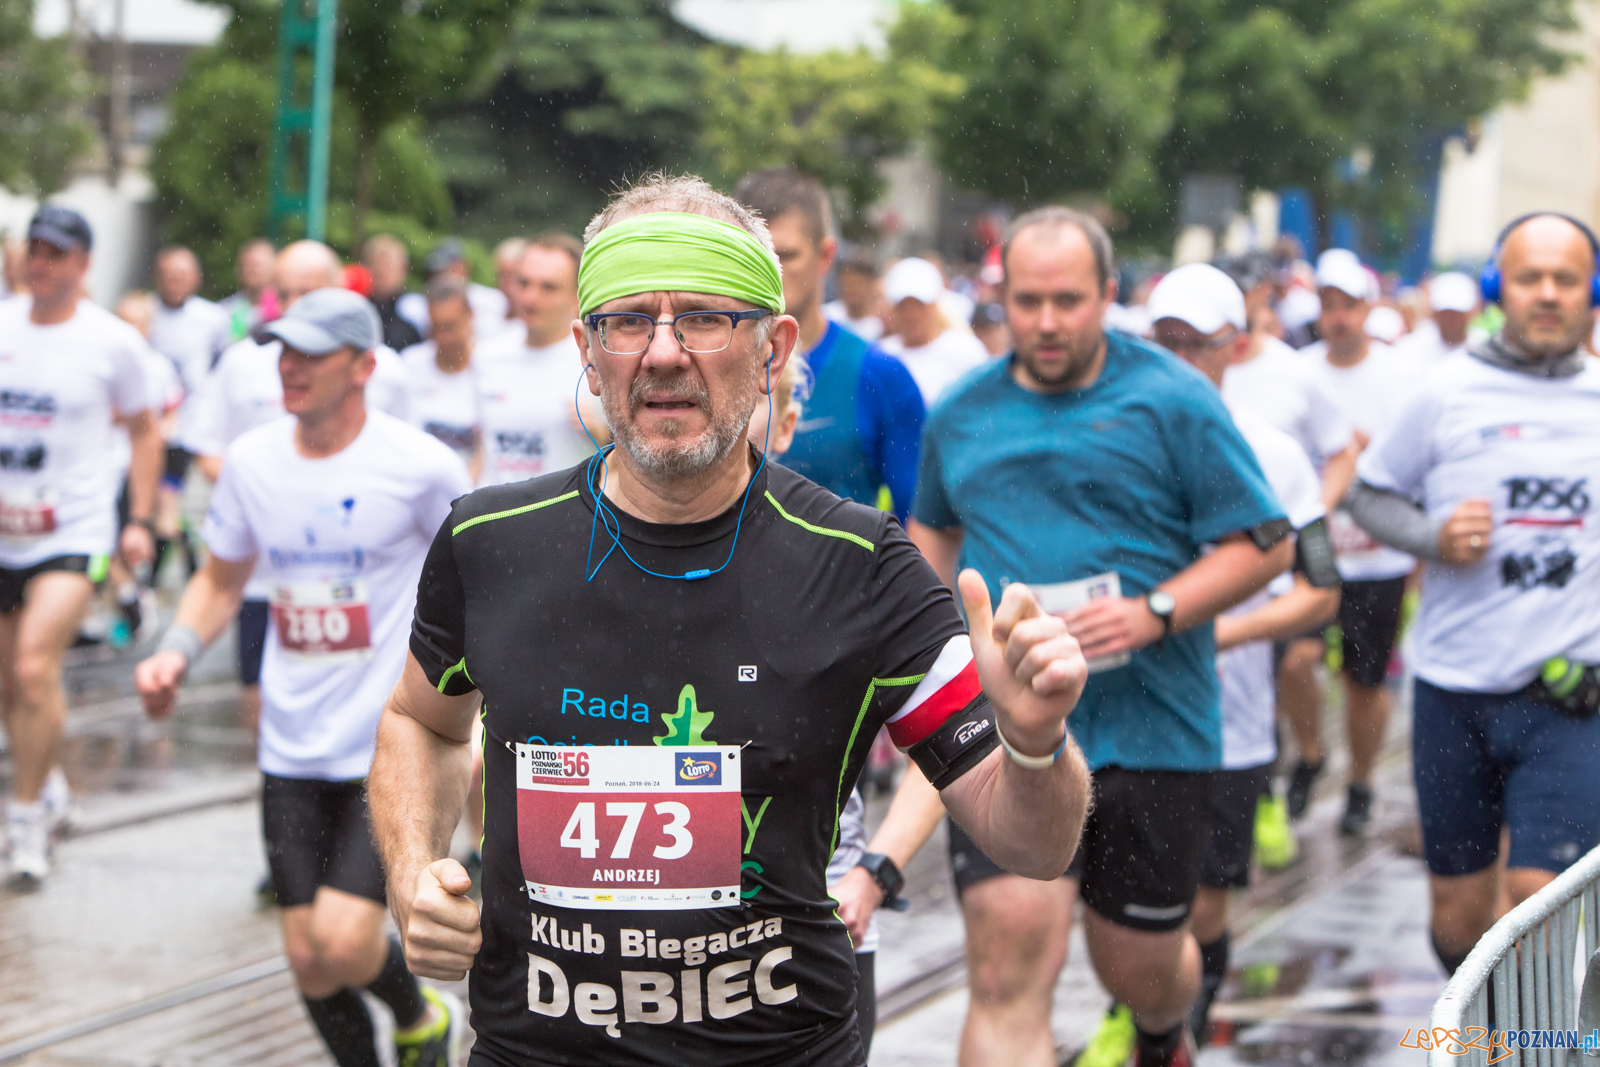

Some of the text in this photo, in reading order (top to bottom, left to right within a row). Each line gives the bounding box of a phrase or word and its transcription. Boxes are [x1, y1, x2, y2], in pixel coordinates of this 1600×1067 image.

[1502, 476, 1590, 514] 1956
[560, 688, 650, 724] Rada
[958, 719, 990, 745] Enea
[531, 750, 557, 761] LOTTO
[531, 767, 563, 776] CZERWIEC
[686, 764, 711, 777] LOTTO
[629, 780, 660, 788] 2018-06-24
[560, 801, 694, 860] 473
[592, 869, 660, 885] ANDRZEJ
[530, 912, 783, 967] Klub Biegacza
